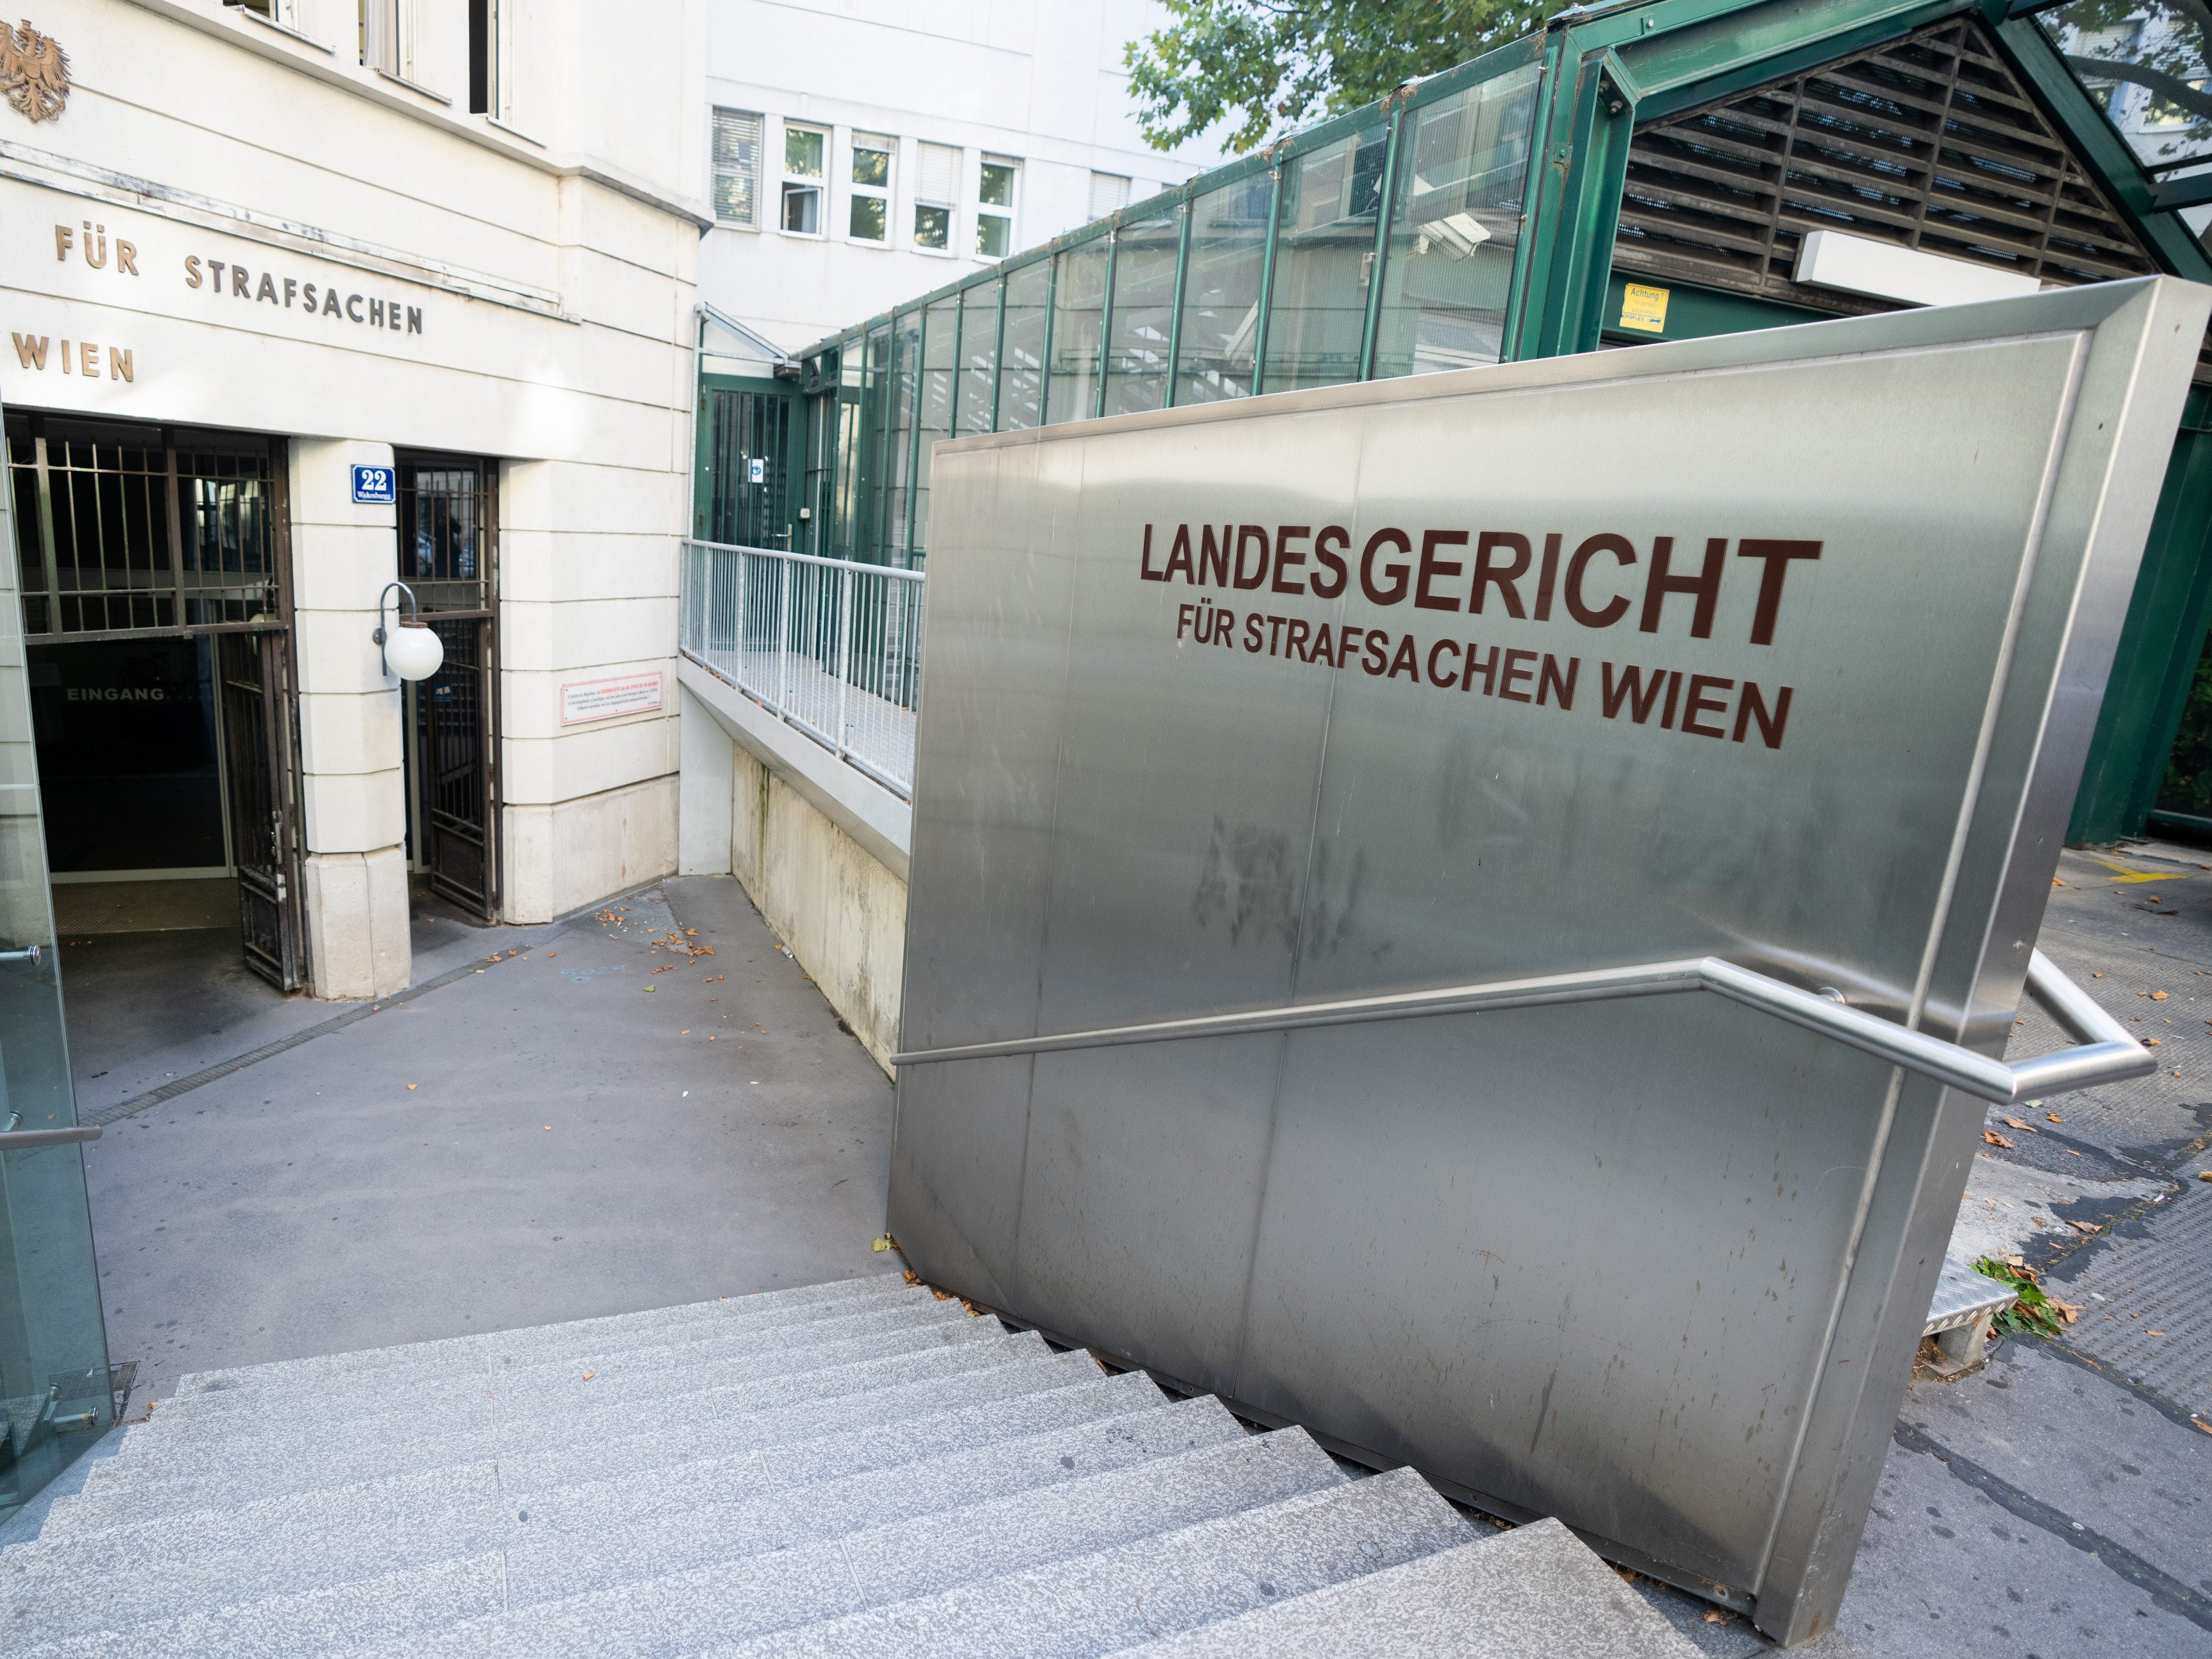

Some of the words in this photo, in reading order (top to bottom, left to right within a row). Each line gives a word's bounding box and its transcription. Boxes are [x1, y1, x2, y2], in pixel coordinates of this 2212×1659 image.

[55, 220, 140, 276] FÜR
[185, 255, 423, 334] STRAFSACHEN
[12, 332, 135, 382] WIEN
[361, 469, 387, 491] 22
[1141, 523, 1825, 645] LANDESGERICHT
[67, 688, 164, 701] EINGANG
[1177, 597, 1236, 649] FÜR
[1243, 613, 1581, 711] STRAFSACHEN
[1602, 661, 1794, 749] WIEN
